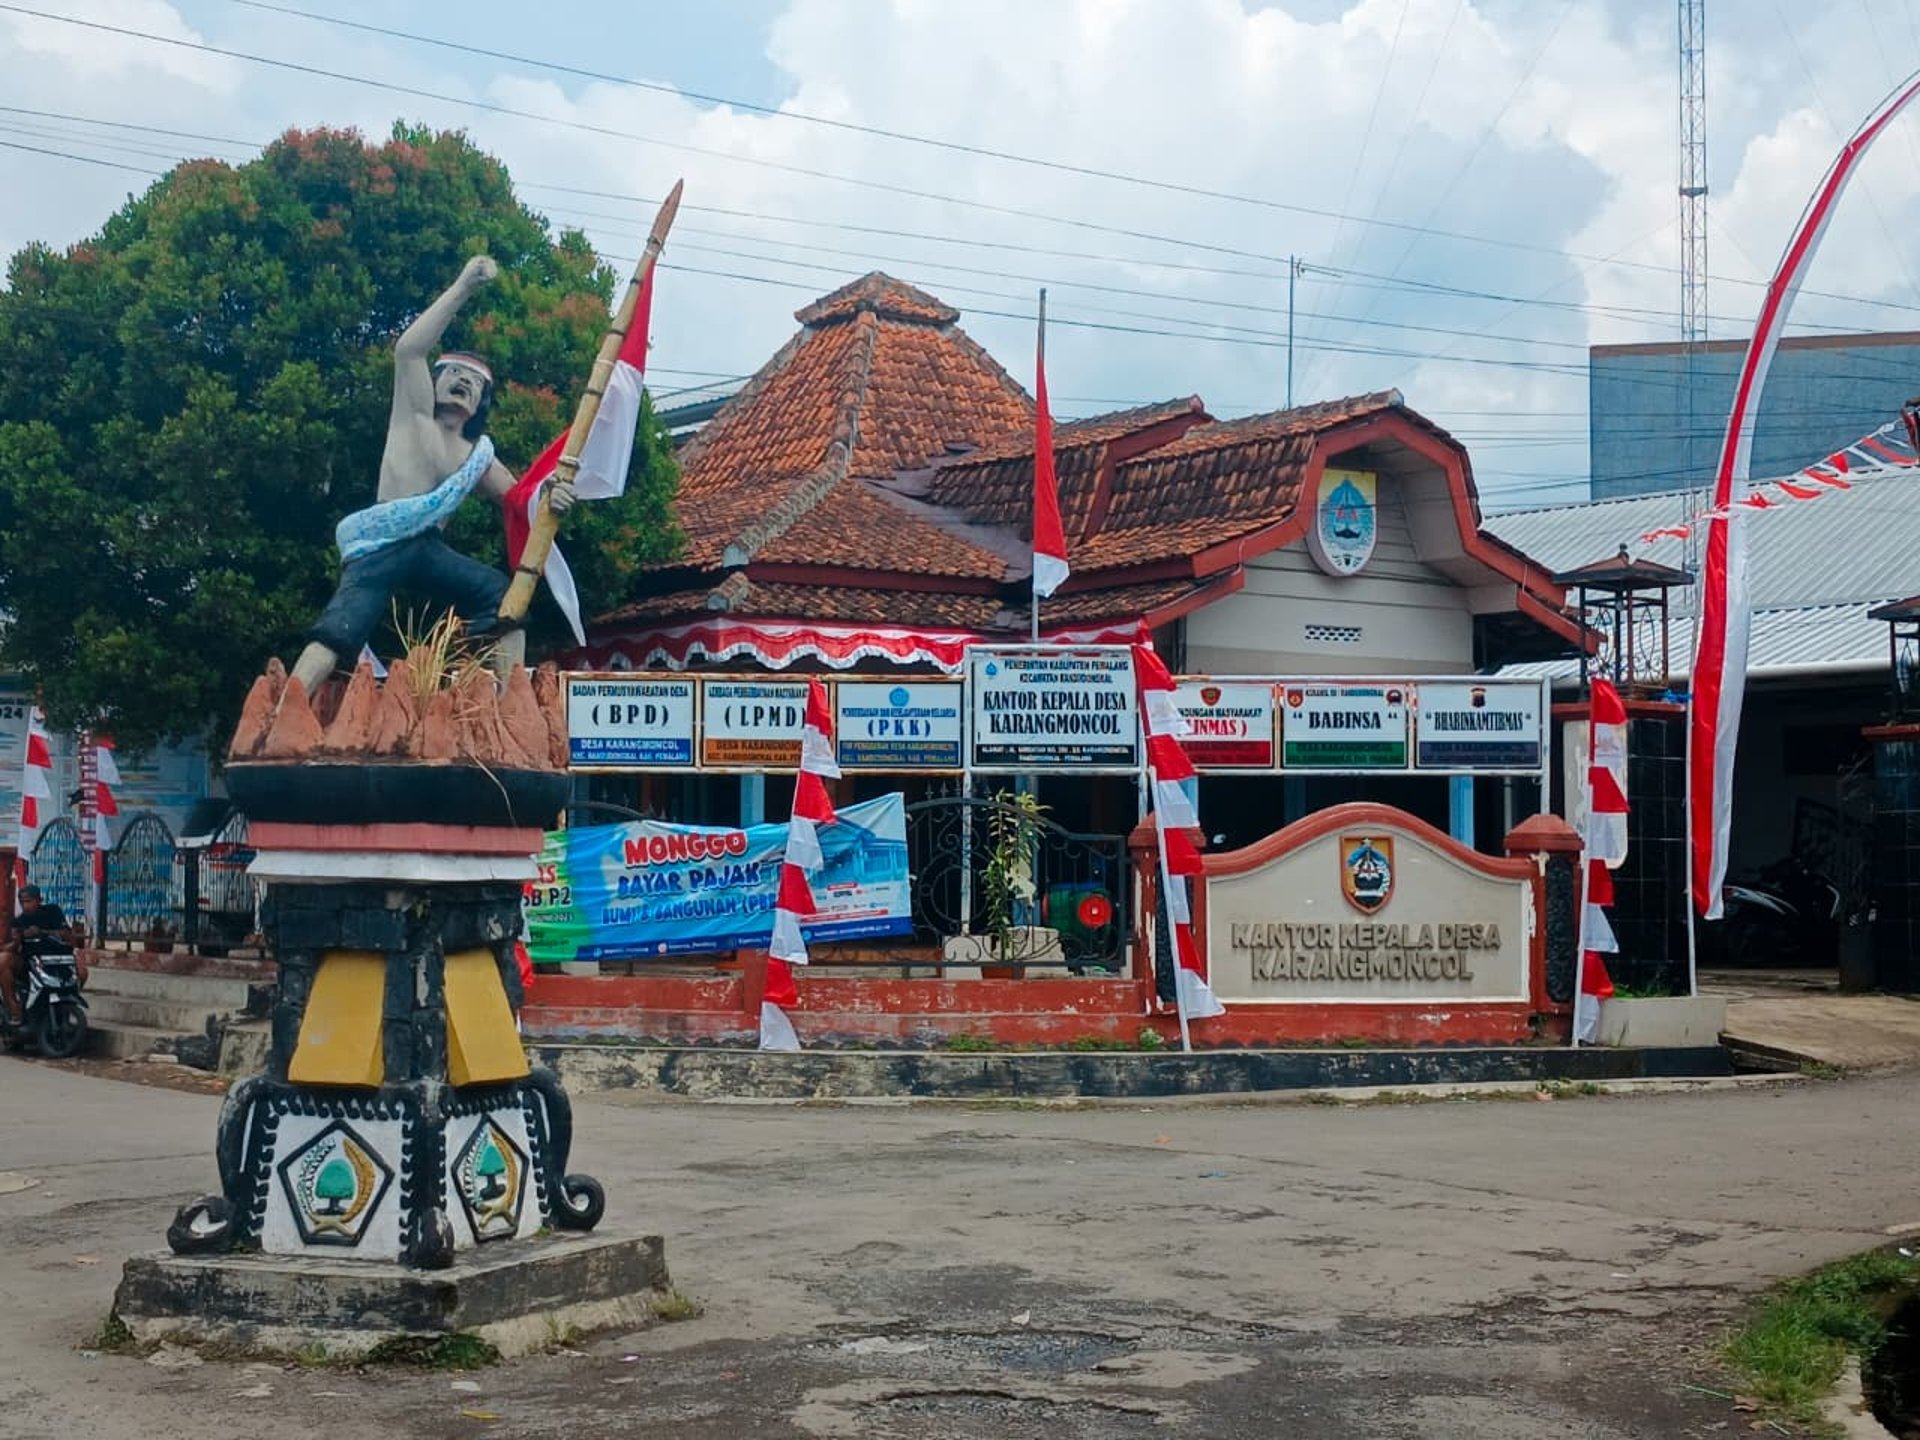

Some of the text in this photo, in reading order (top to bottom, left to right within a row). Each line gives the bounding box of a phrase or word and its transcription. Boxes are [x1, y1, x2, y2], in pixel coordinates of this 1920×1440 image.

[572, 685, 596, 697] BADAN
[670, 685, 689, 697] DESA
[984, 691, 1127, 711] KANTOR KEPALA DESA
[990, 713, 1121, 735] KARANGMONCOL
[1309, 711, 1382, 730] BABINSA
[624, 832, 747, 866] MONGGO
[618, 862, 761, 896] BAYAR PAJAK
[602, 907, 636, 925] BUMI
[655, 896, 739, 921] BANGUNAN
[1231, 923, 1502, 950] KANTOR KEPALA DESA
[1250, 949, 1474, 982] KARANGMONCOL
